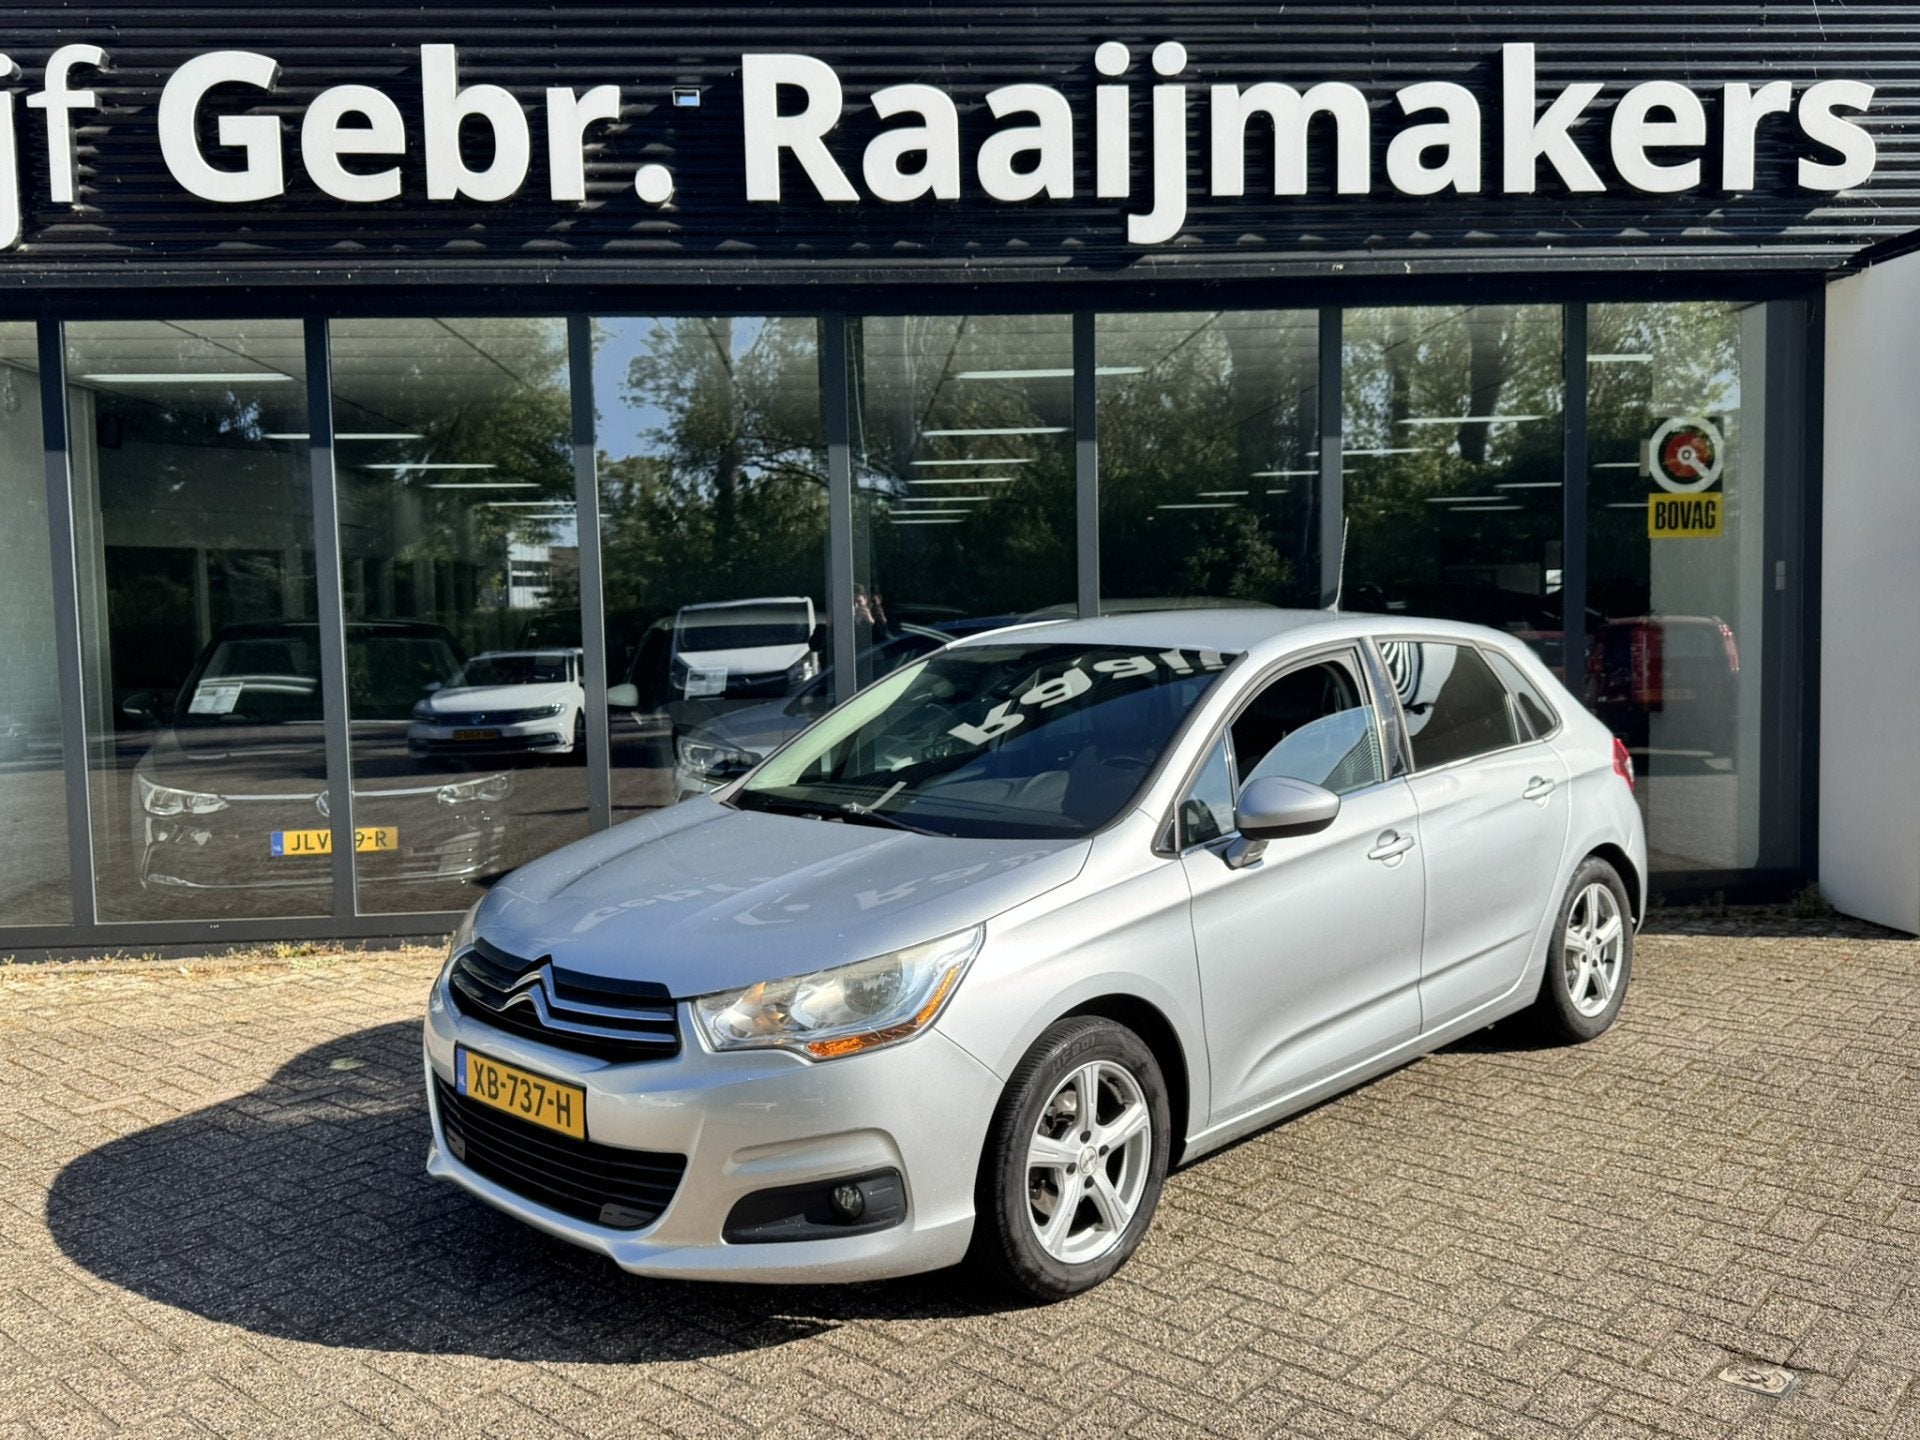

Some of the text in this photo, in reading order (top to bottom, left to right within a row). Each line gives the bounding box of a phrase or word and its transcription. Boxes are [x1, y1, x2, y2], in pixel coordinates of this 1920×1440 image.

[158, 43, 673, 203] Gebr.
[742, 41, 1877, 245] Raaijmakers
[1655, 500, 1717, 530] BOVAG
[291, 830, 387, 852] JLV9-R
[473, 1060, 571, 1128] XB-737-H
